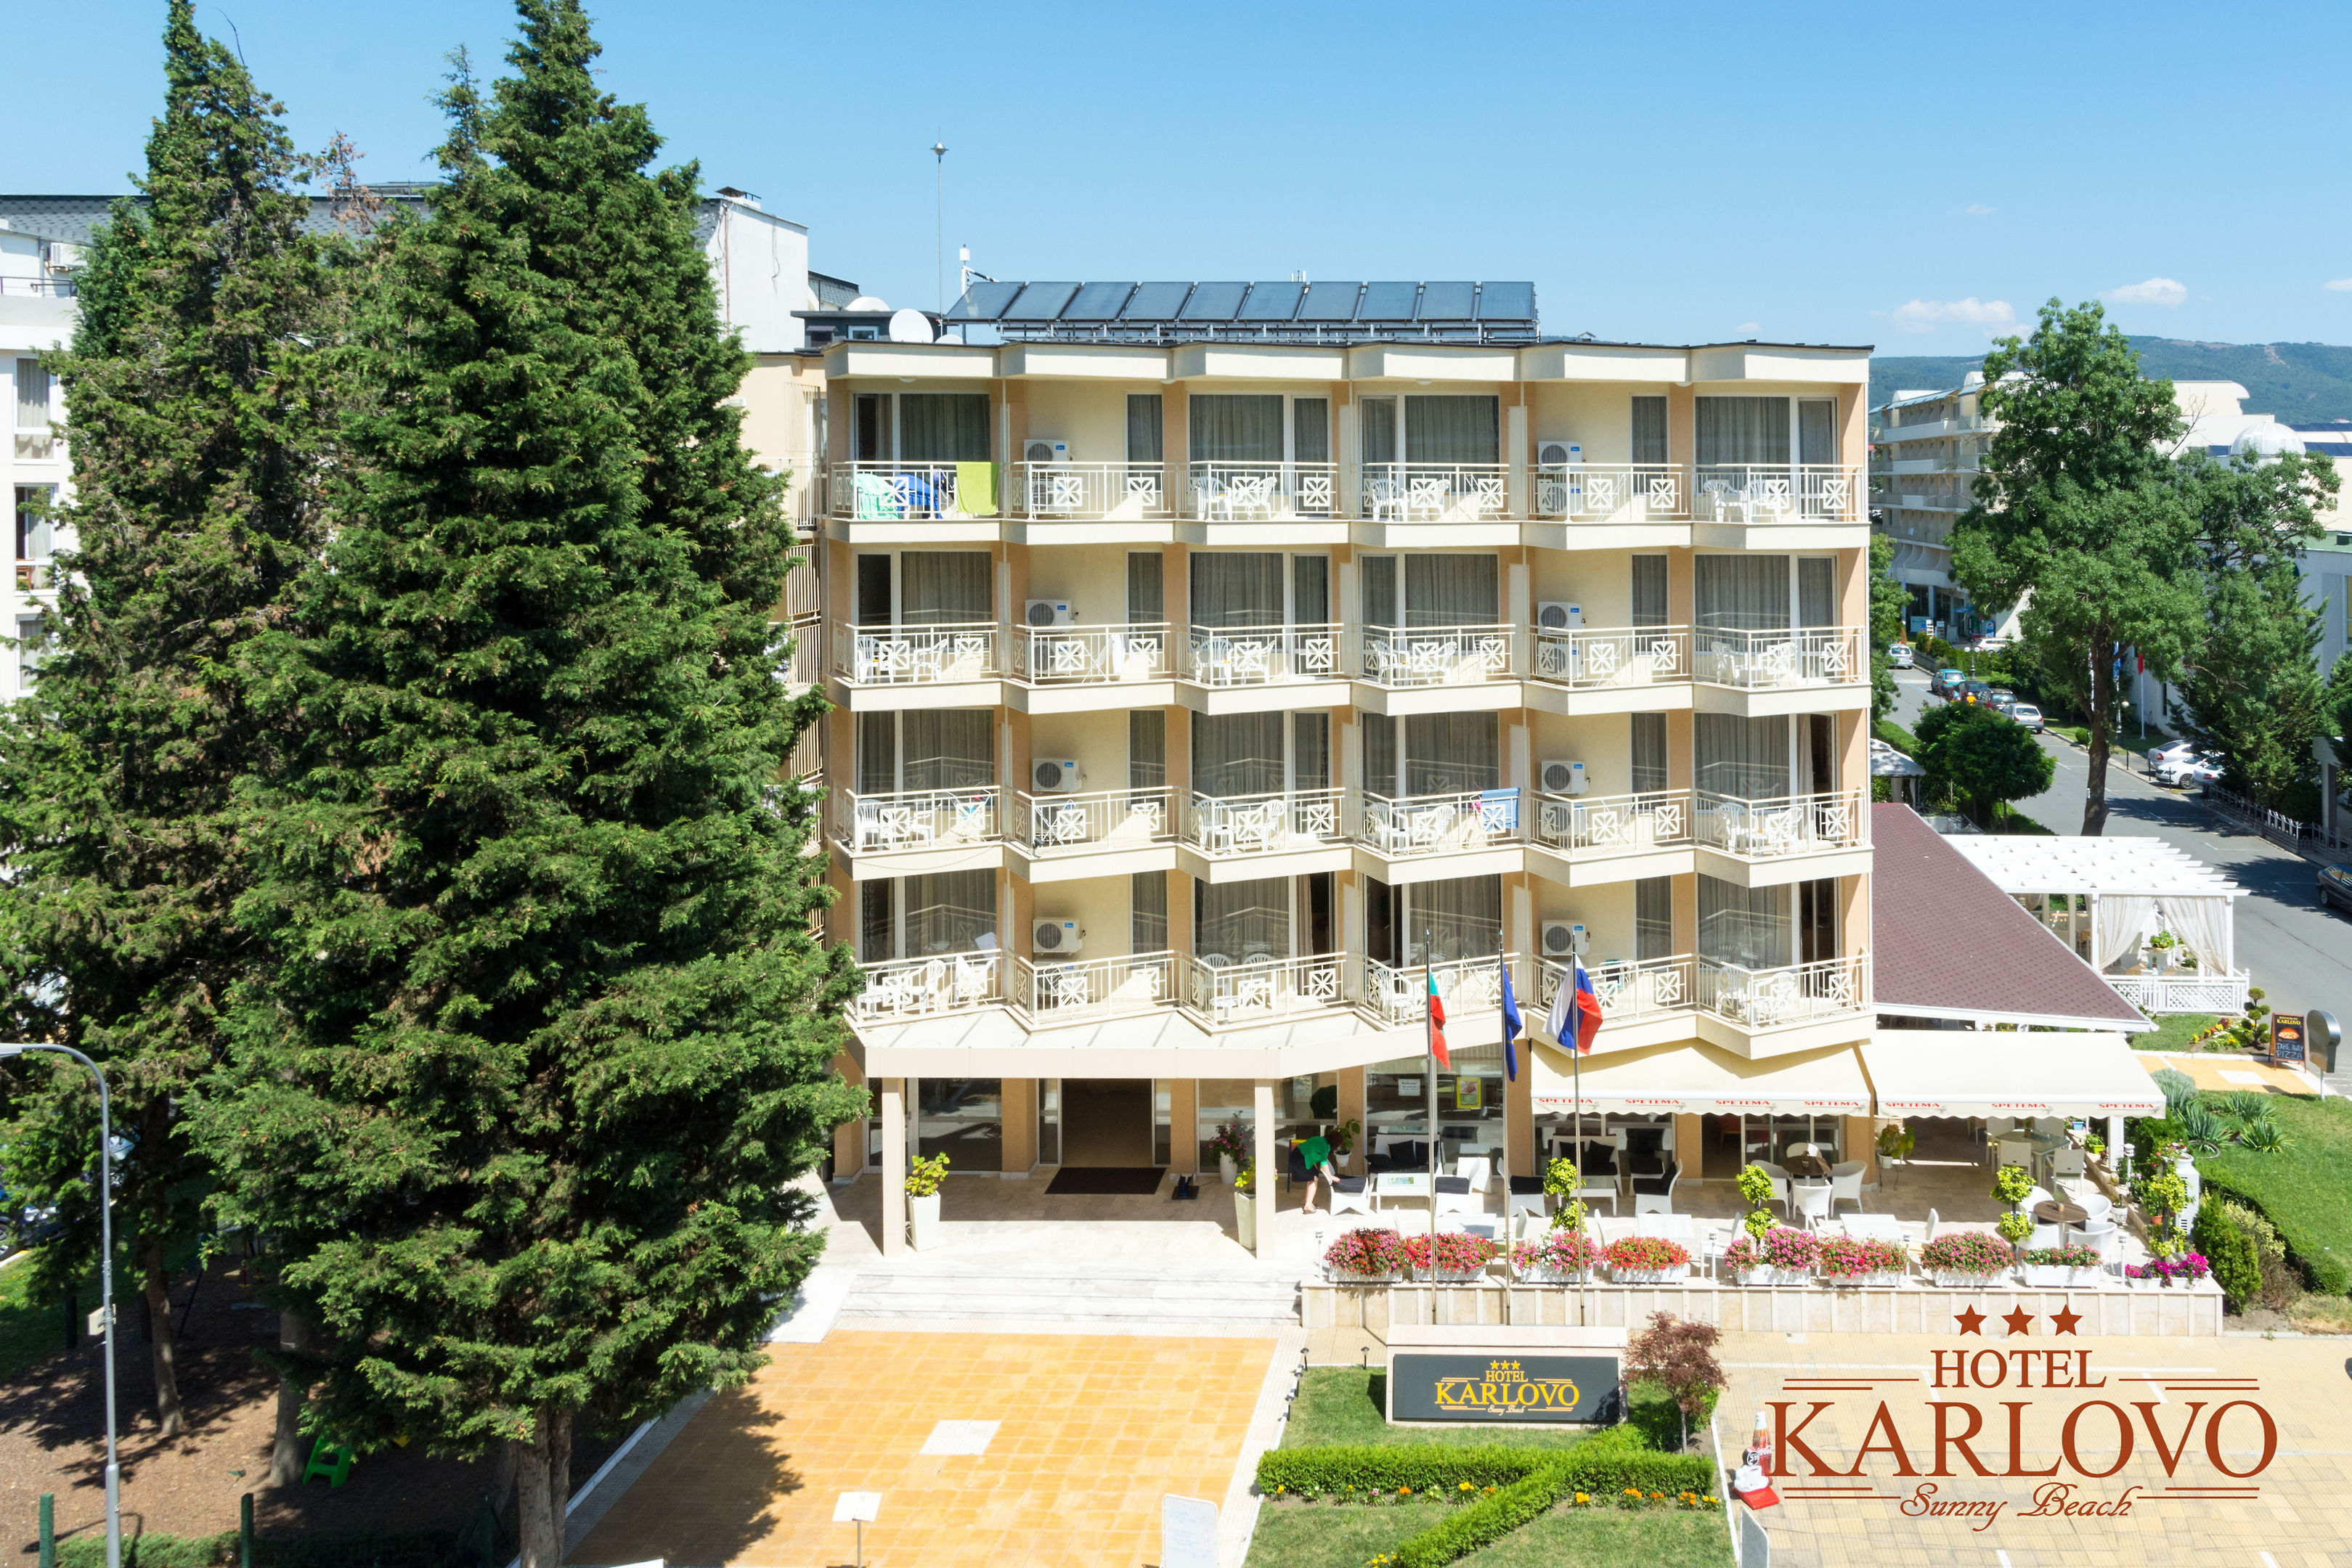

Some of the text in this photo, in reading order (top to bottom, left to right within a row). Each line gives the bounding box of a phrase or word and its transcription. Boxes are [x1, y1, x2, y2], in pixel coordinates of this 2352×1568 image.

[2276, 1050, 2302, 1059] PIZZA
[1486, 1370, 1528, 1383] HOTEL
[1434, 1382, 1580, 1406] KARLOVO
